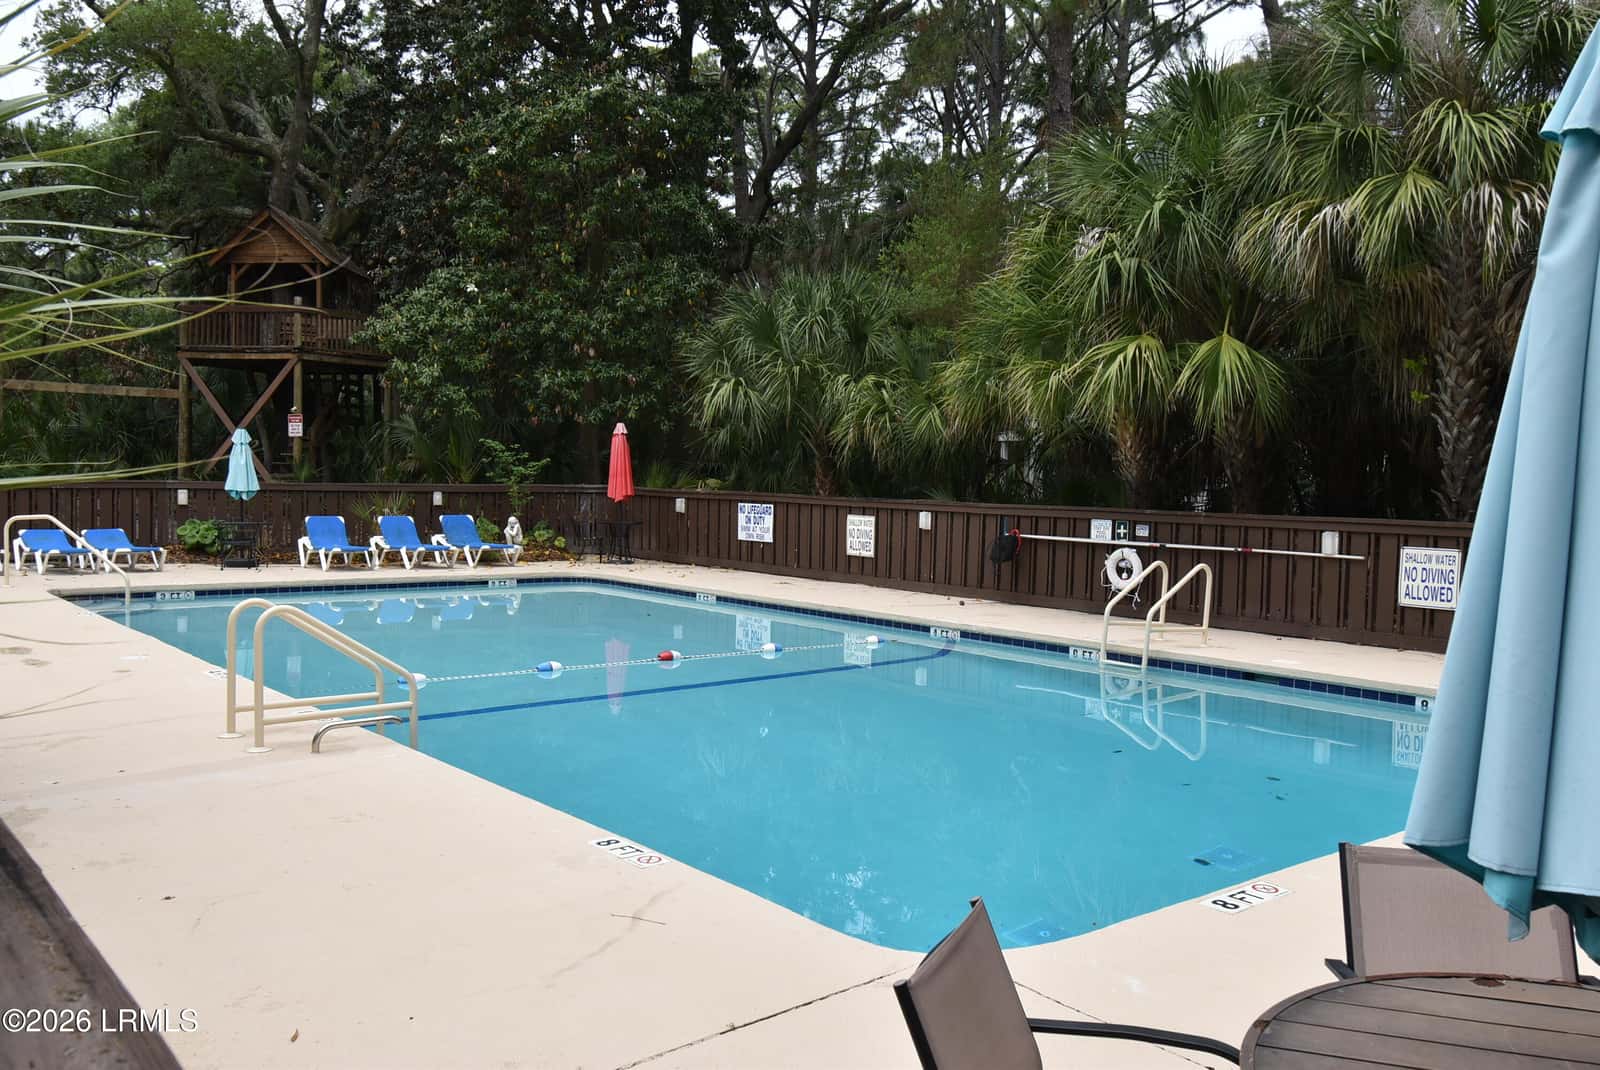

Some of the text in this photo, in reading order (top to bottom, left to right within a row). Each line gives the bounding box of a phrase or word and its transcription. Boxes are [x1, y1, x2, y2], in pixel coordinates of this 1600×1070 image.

[739, 504, 772, 515] NO LIFEGUARD
[744, 515, 765, 525] ON DUTY
[848, 528, 872, 540] NO DIVING
[849, 540, 872, 552] ALLOWED
[1405, 552, 1457, 566] SHALLOW WATER
[1404, 566, 1455, 585] NO DIVING
[1404, 584, 1453, 603] ALLOWED
[609, 845, 645, 856] FT
[1211, 890, 1265, 910] 8 FT
